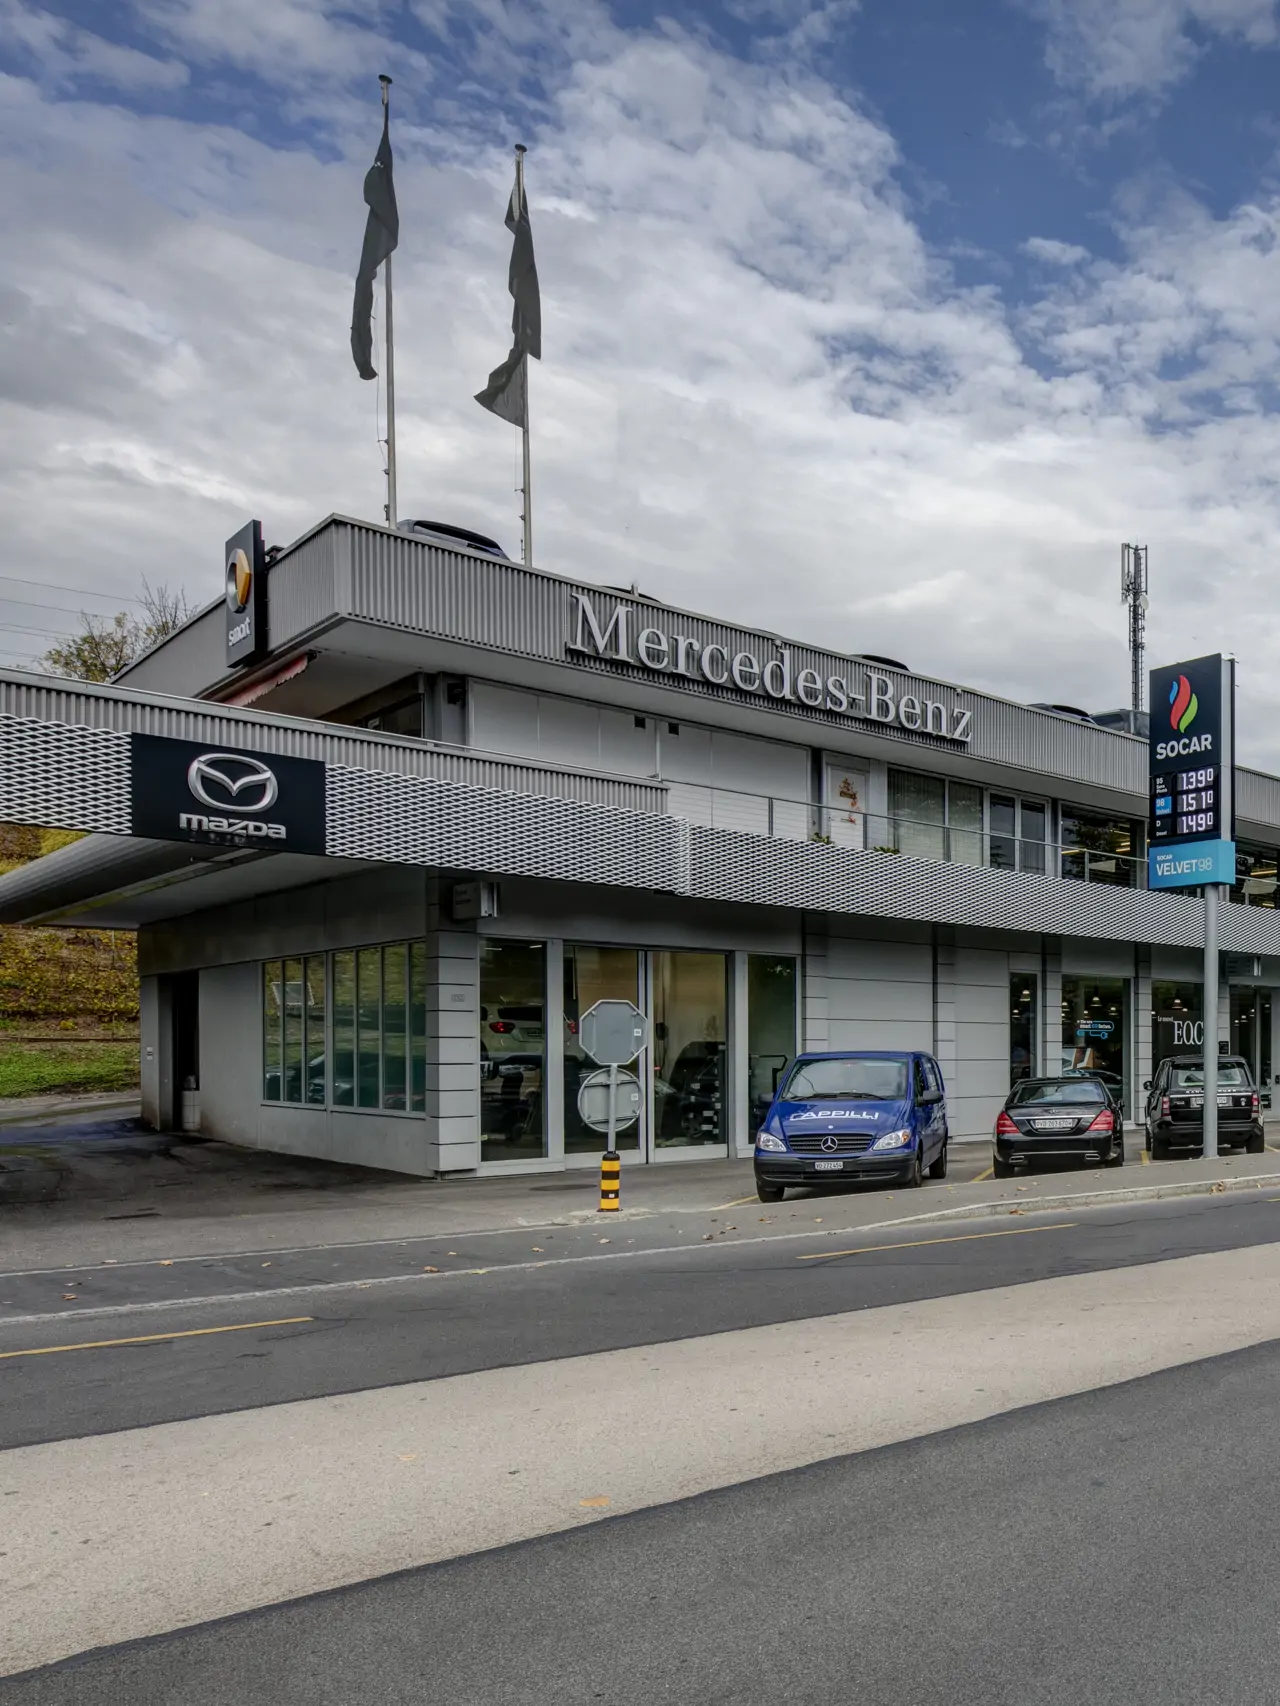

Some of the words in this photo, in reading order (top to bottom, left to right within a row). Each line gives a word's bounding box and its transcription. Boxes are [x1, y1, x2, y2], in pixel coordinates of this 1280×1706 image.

[228, 616, 251, 646] smart
[569, 592, 973, 742] Mercedes-Benz
[1155, 733, 1213, 760] SOCAR
[1156, 798, 1165, 807] 98
[1173, 1020, 1204, 1045] EQC
